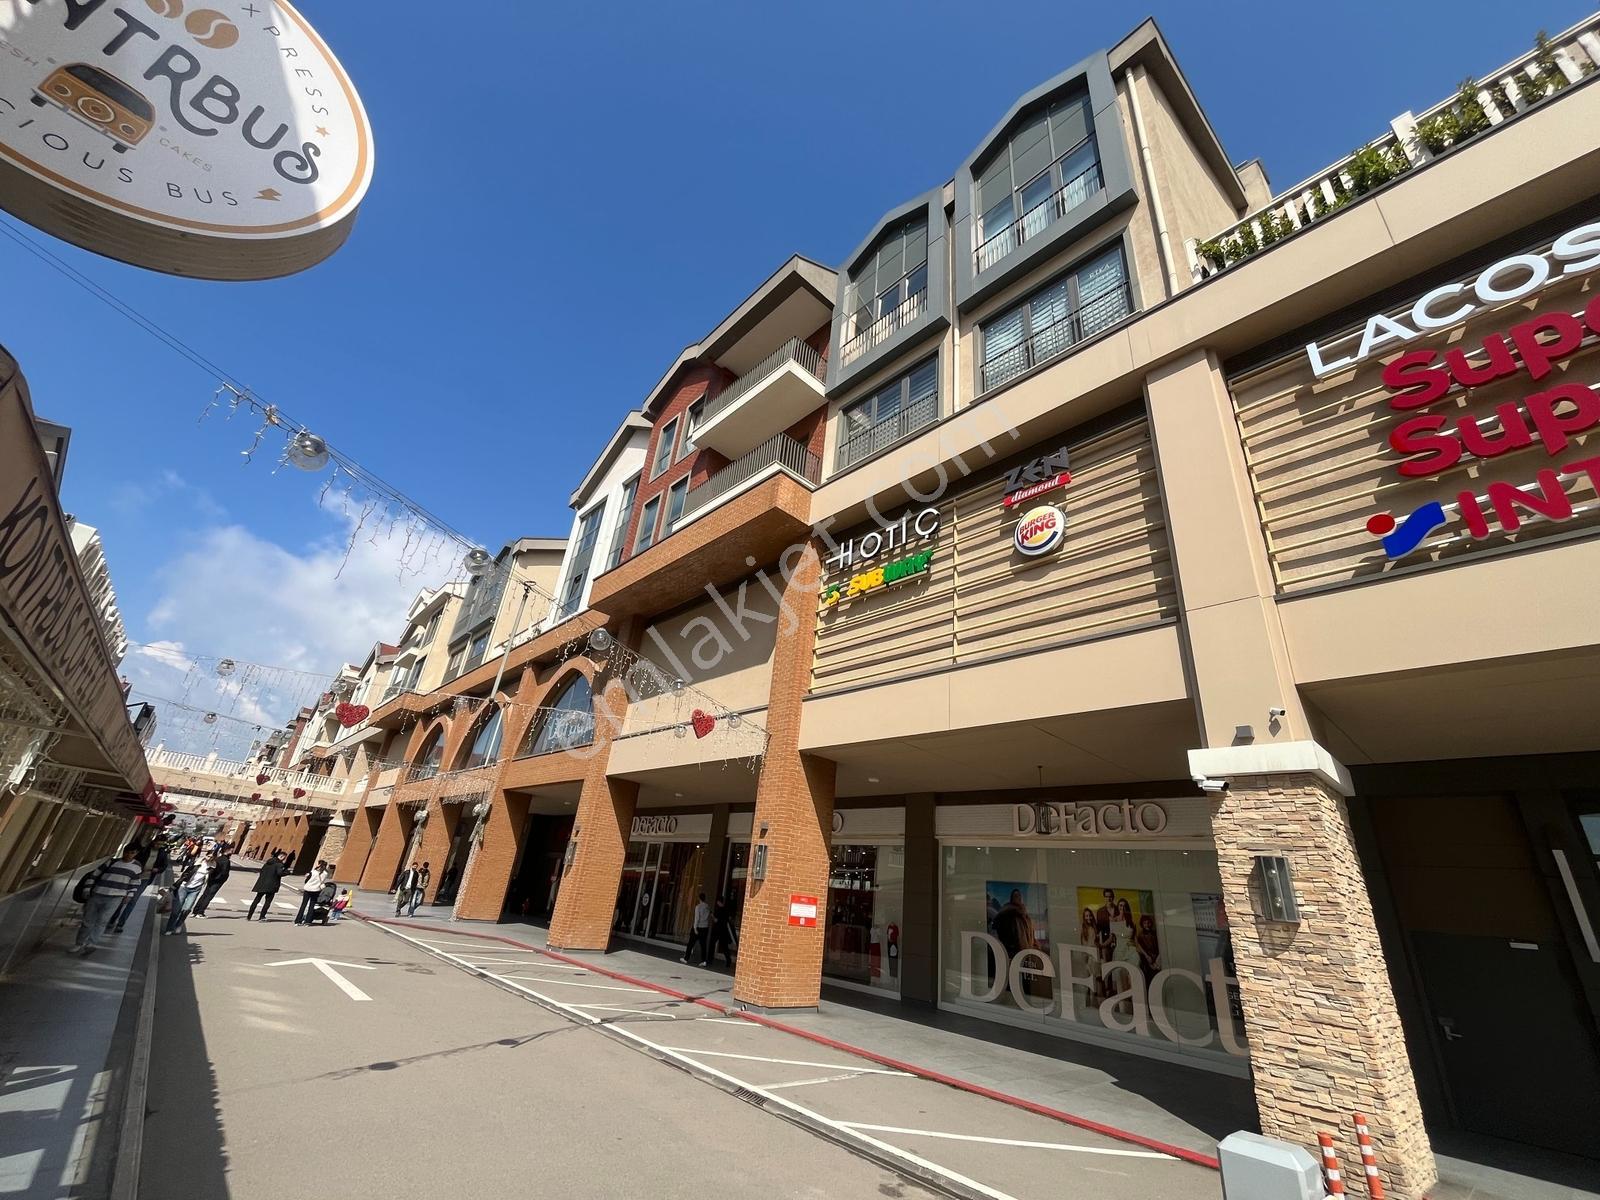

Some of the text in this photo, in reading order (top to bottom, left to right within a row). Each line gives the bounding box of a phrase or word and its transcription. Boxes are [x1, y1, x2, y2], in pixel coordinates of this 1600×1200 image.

[241, 3, 330, 117] XPRESS
[159, 137, 213, 172] CAKES
[166, 181, 239, 206] BUS
[1306, 222, 1600, 378] LACOS
[1381, 293, 1600, 411] Sup
[1011, 475, 1060, 502] diamond
[1019, 511, 1055, 535] BURGER
[1020, 518, 1056, 545] KING
[847, 549, 934, 597] SUBWAY
